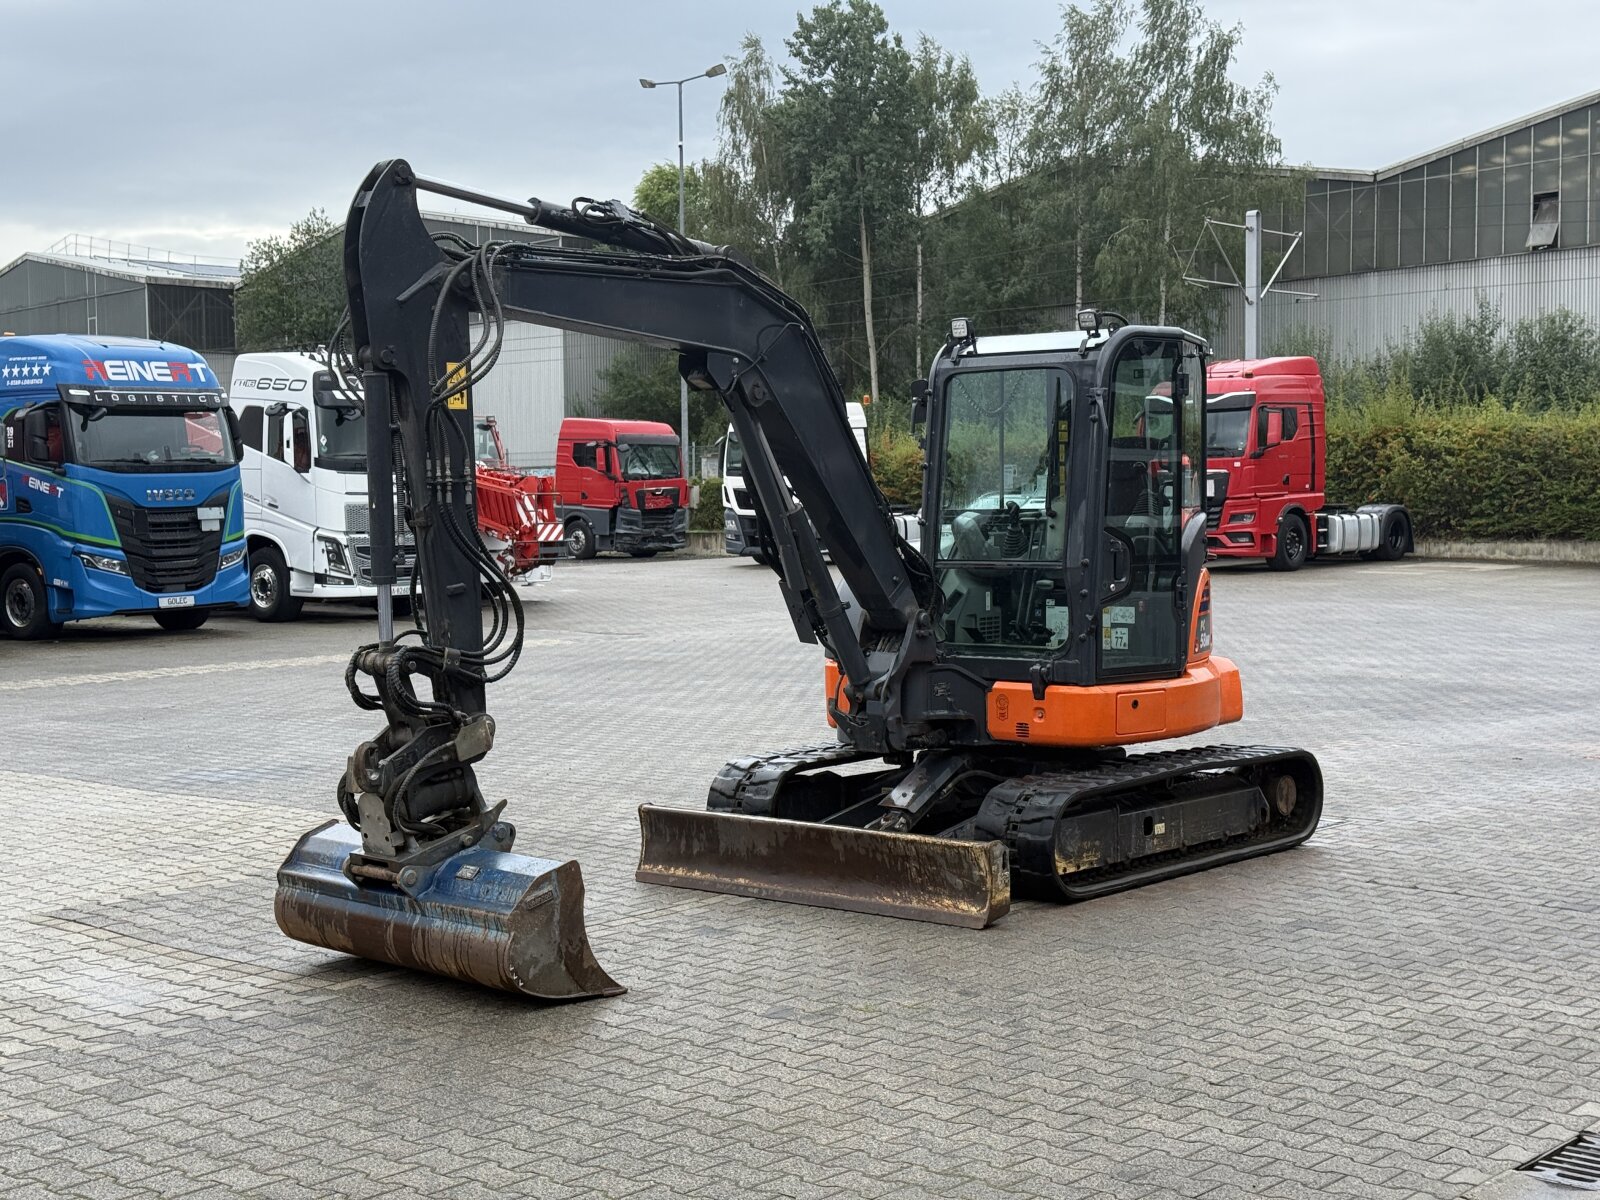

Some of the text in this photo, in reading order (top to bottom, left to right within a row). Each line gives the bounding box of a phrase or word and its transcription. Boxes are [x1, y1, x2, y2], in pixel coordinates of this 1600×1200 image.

[82, 359, 207, 382] REINERT
[256, 377, 308, 392] 650
[94, 393, 221, 403] LOGISTICS
[146, 488, 195, 501] IVECO
